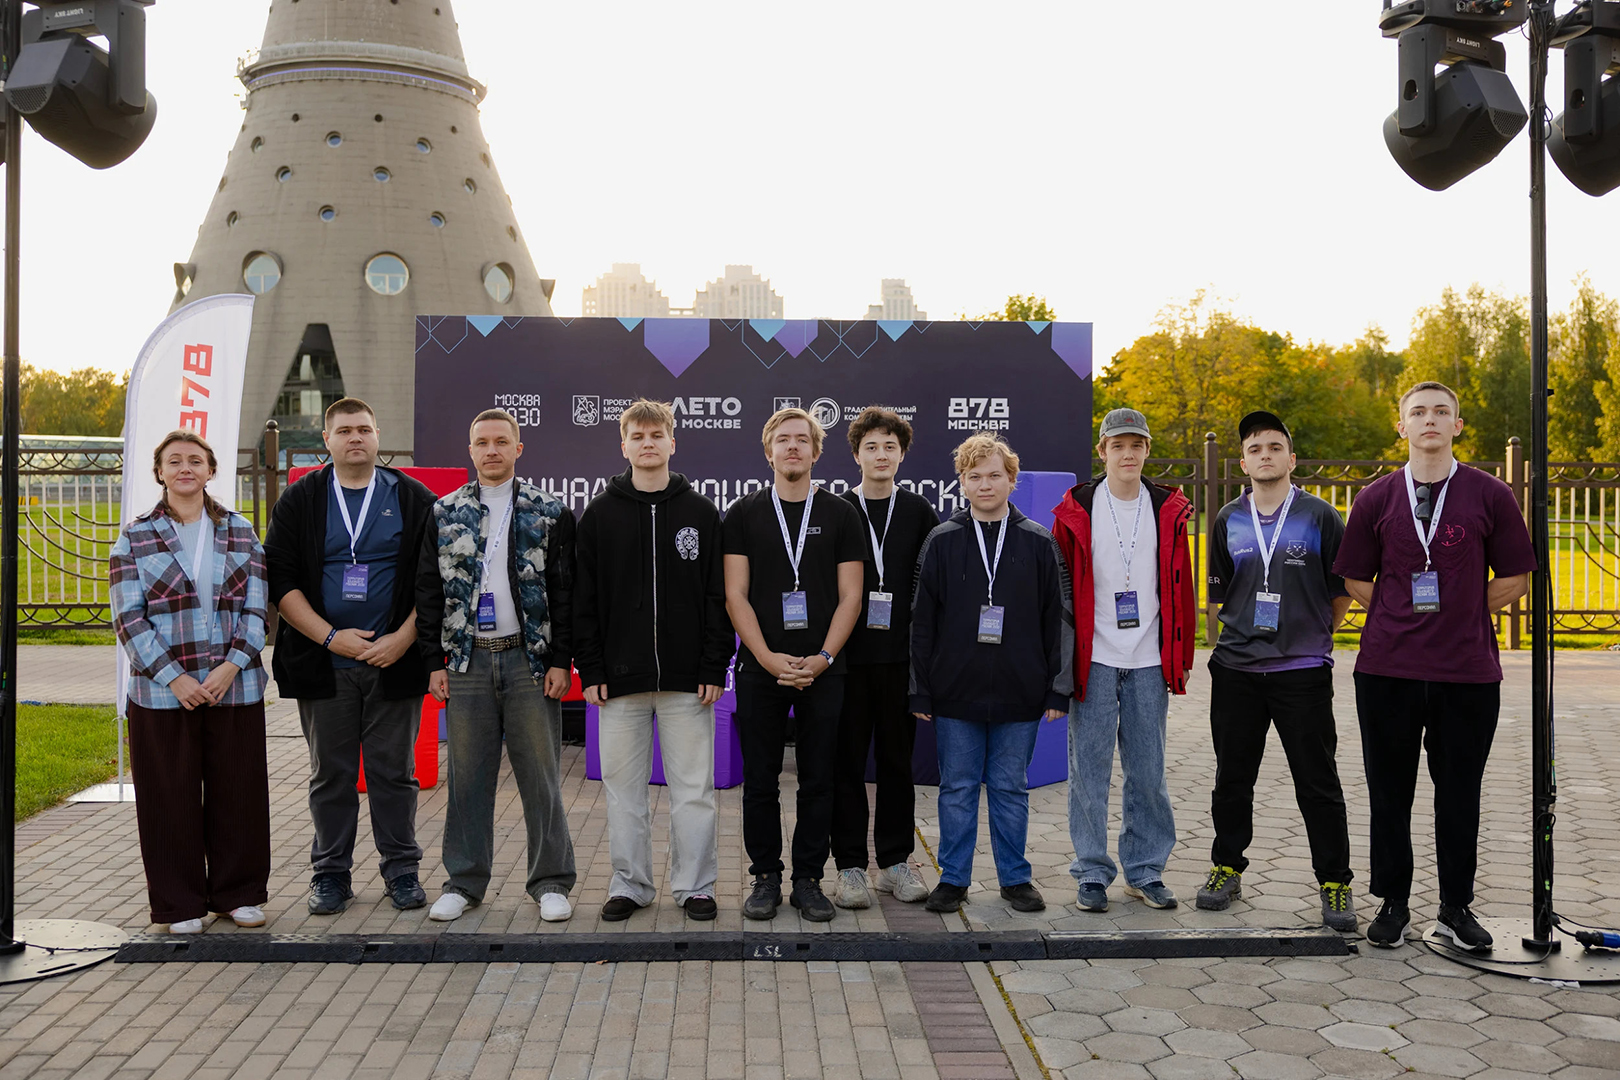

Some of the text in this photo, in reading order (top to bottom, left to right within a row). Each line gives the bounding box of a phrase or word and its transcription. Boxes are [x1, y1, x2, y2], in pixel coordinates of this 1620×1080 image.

[494, 394, 541, 406] МОСКВА
[671, 396, 742, 416] ЛЕТО
[948, 398, 1010, 418] 878
[681, 418, 742, 429] МОСКВЕ
[947, 419, 1010, 430] МОСКВА
